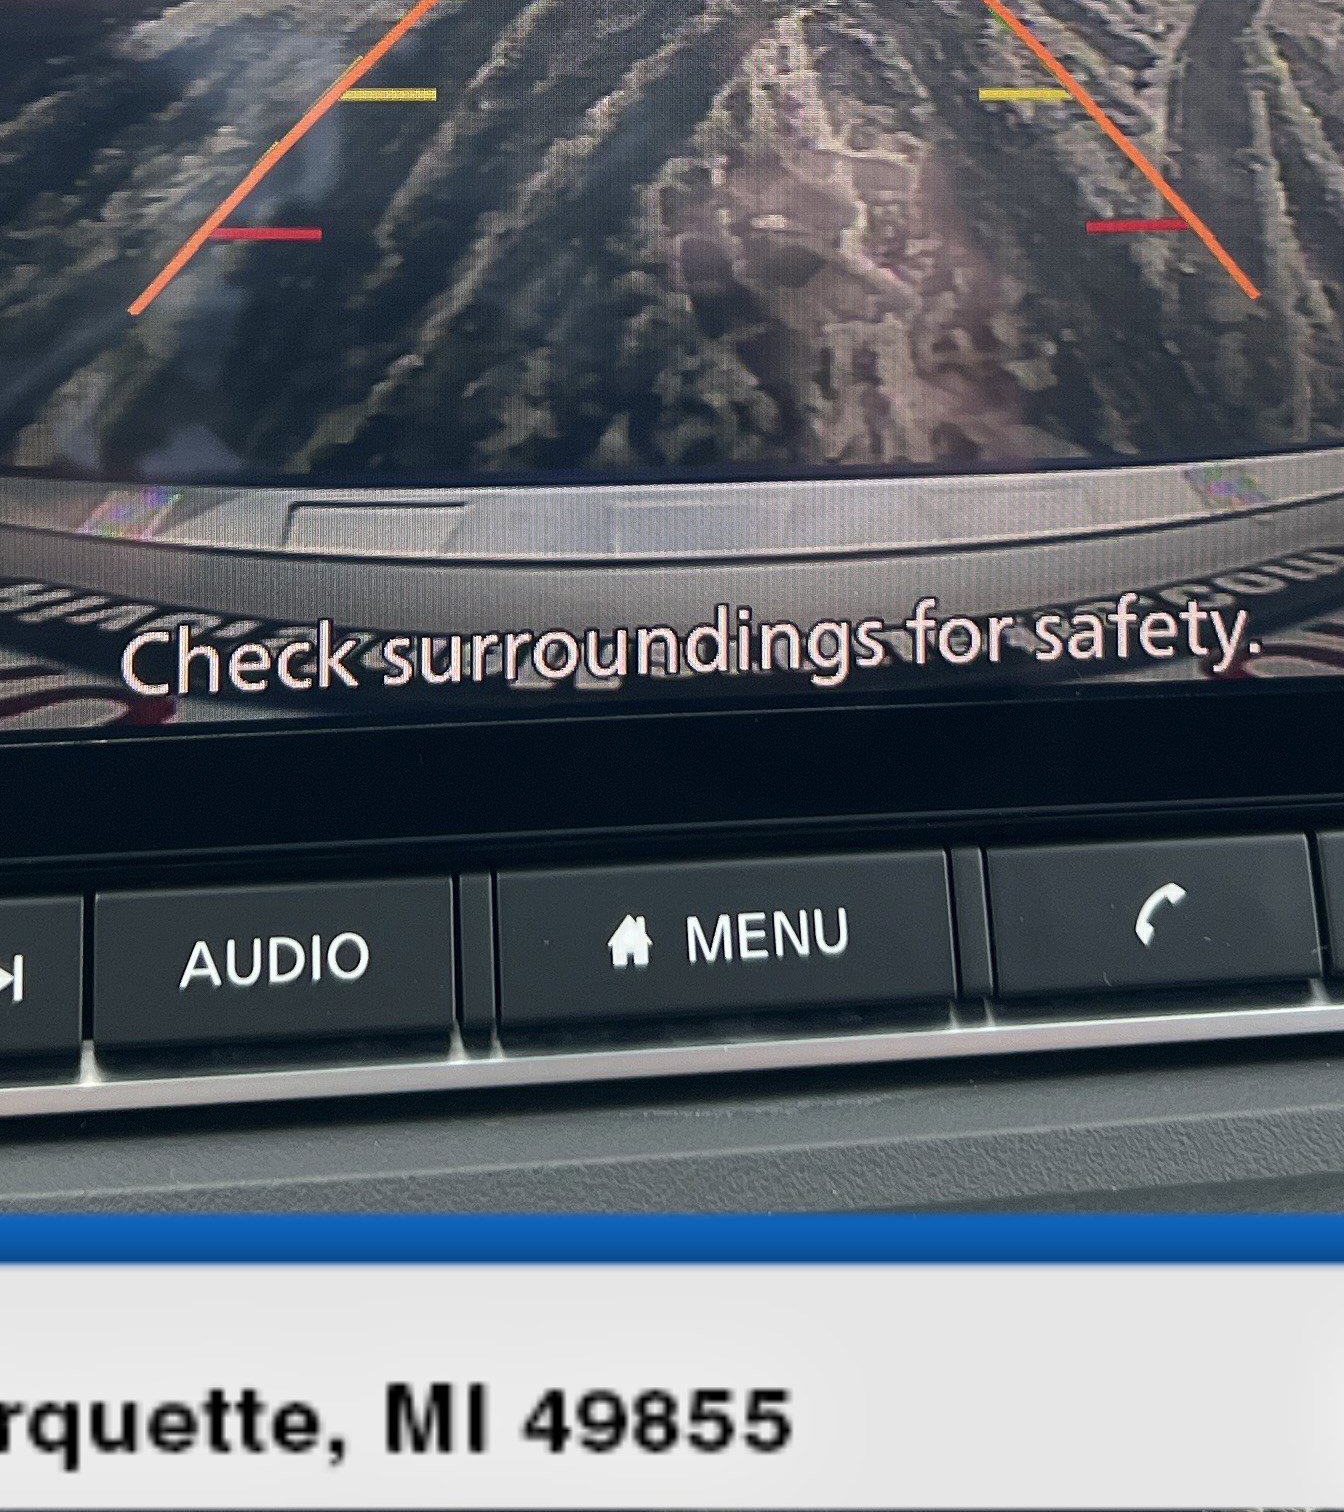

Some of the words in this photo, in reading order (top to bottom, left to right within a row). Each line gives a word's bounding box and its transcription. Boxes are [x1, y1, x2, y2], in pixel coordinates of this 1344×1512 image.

[120, 619, 358, 697] Check
[382, 604, 887, 687] surroundings
[906, 597, 1017, 665] for
[1034, 592, 1262, 674] safety.
[179, 932, 370, 990] AUDIO
[686, 908, 849, 963] MENU
